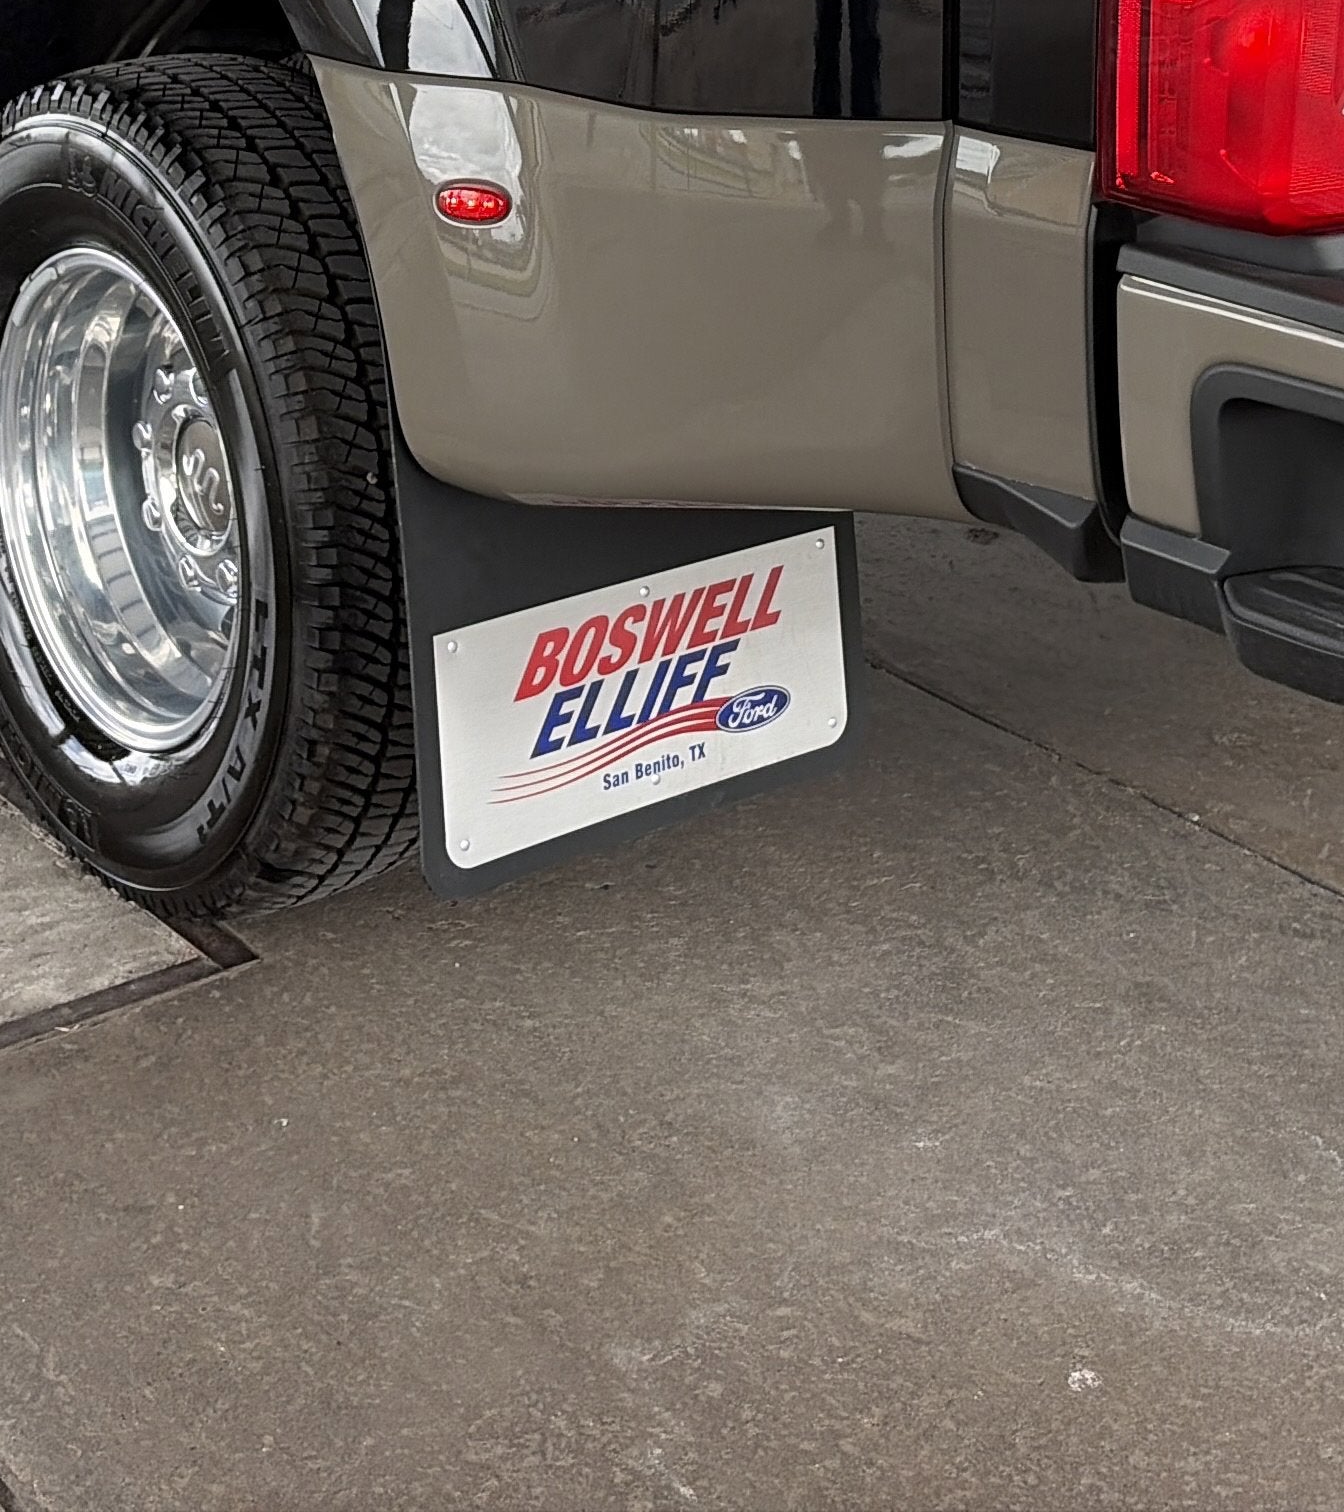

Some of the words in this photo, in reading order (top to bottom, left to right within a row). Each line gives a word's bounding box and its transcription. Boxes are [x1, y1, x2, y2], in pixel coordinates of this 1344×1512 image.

[100, 167, 235, 368] MICHELIN
[513, 565, 784, 703] BOSWELL
[530, 638, 740, 760] ELLIFF
[728, 694, 779, 728] Ford
[603, 771, 630, 791] San
[635, 750, 685, 784] Benito,
[688, 741, 707, 762] TX
